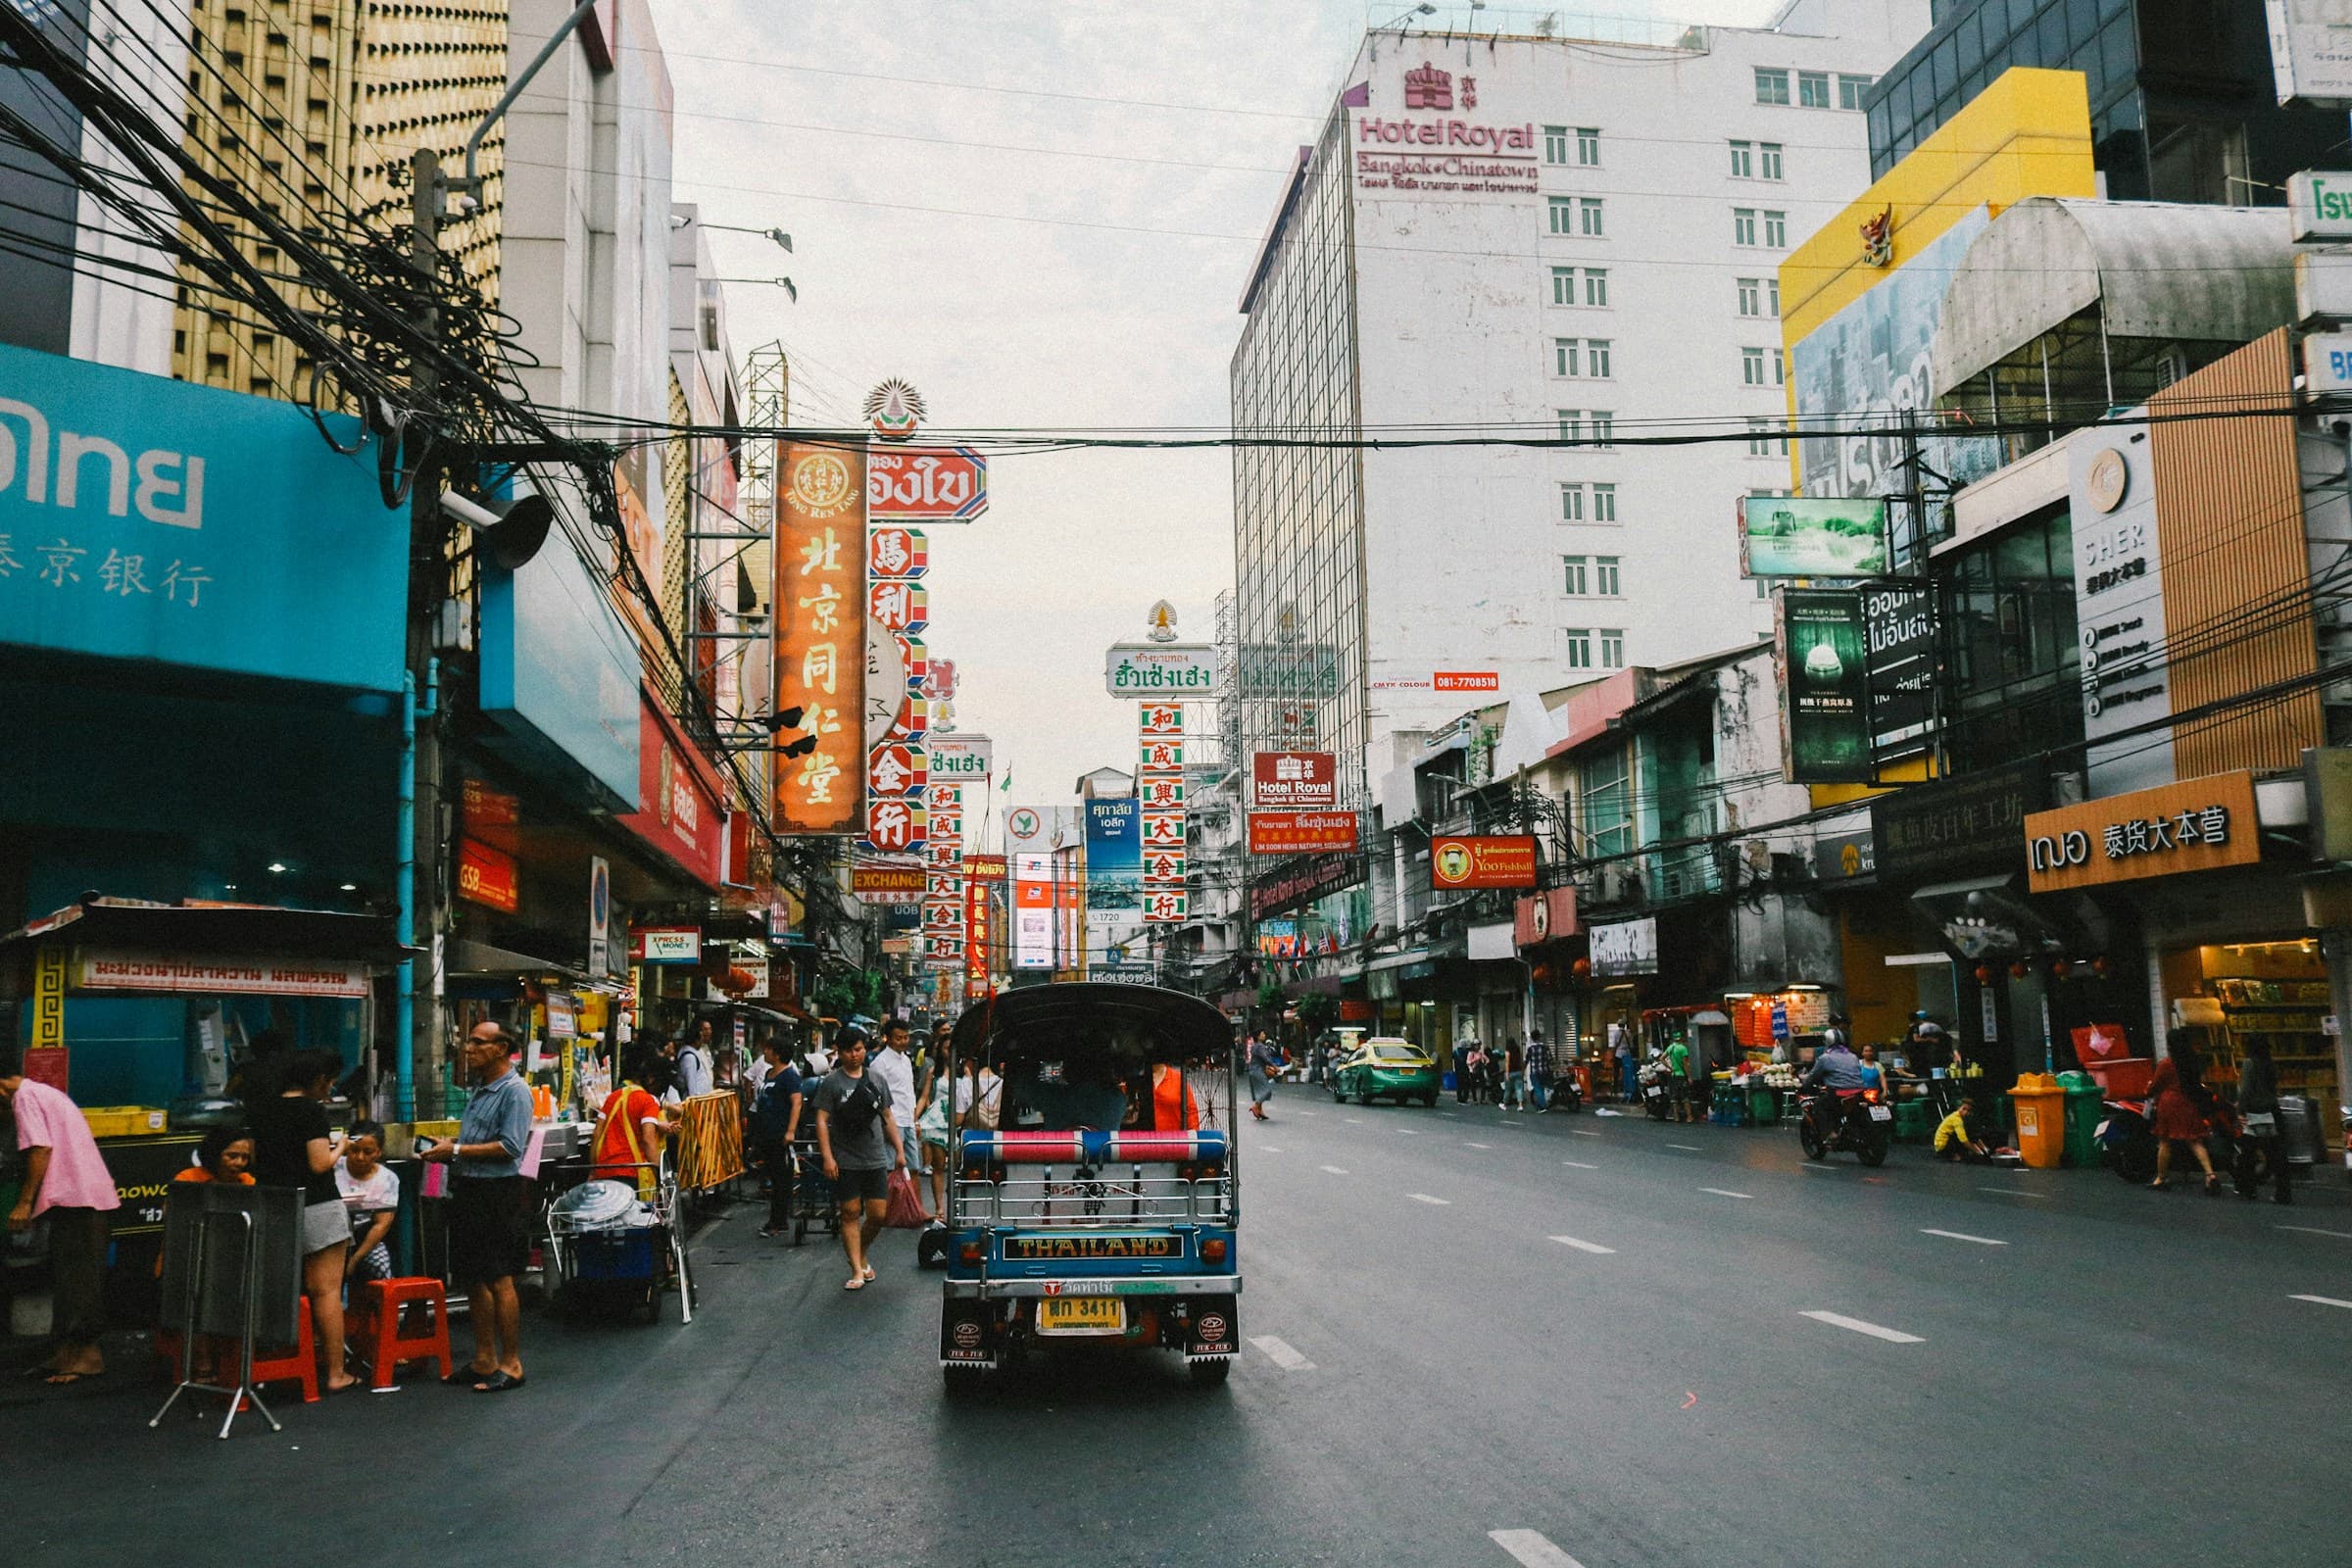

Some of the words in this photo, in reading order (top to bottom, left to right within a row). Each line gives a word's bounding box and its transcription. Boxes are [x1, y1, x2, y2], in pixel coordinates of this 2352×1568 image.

[1359, 117, 1444, 145] Hotel
[1448, 120, 1534, 154] Royal
[797, 525, 843, 806] 北京同仁堂
[870, 531, 911, 847] 馬利金行
[1437, 676, 1497, 687] 081-7708518
[1257, 781, 1292, 794] Hotel
[1295, 780, 1332, 795] Royal
[1258, 795, 1287, 804] Bangkok
[1297, 795, 1332, 804] Chinatown
[1152, 708, 1176, 918] 和成興大金行
[2102, 805, 2228, 860] 泰货大本营
[461, 863, 480, 891] GSB
[854, 873, 925, 887] EXCHANGE
[933, 790, 955, 956] 和成興大金行
[894, 906, 918, 915] UOB
[1099, 912, 1120, 922] 1720
[1018, 1238, 1169, 1257] THAILAND
[1079, 1300, 1117, 1317] 3411
